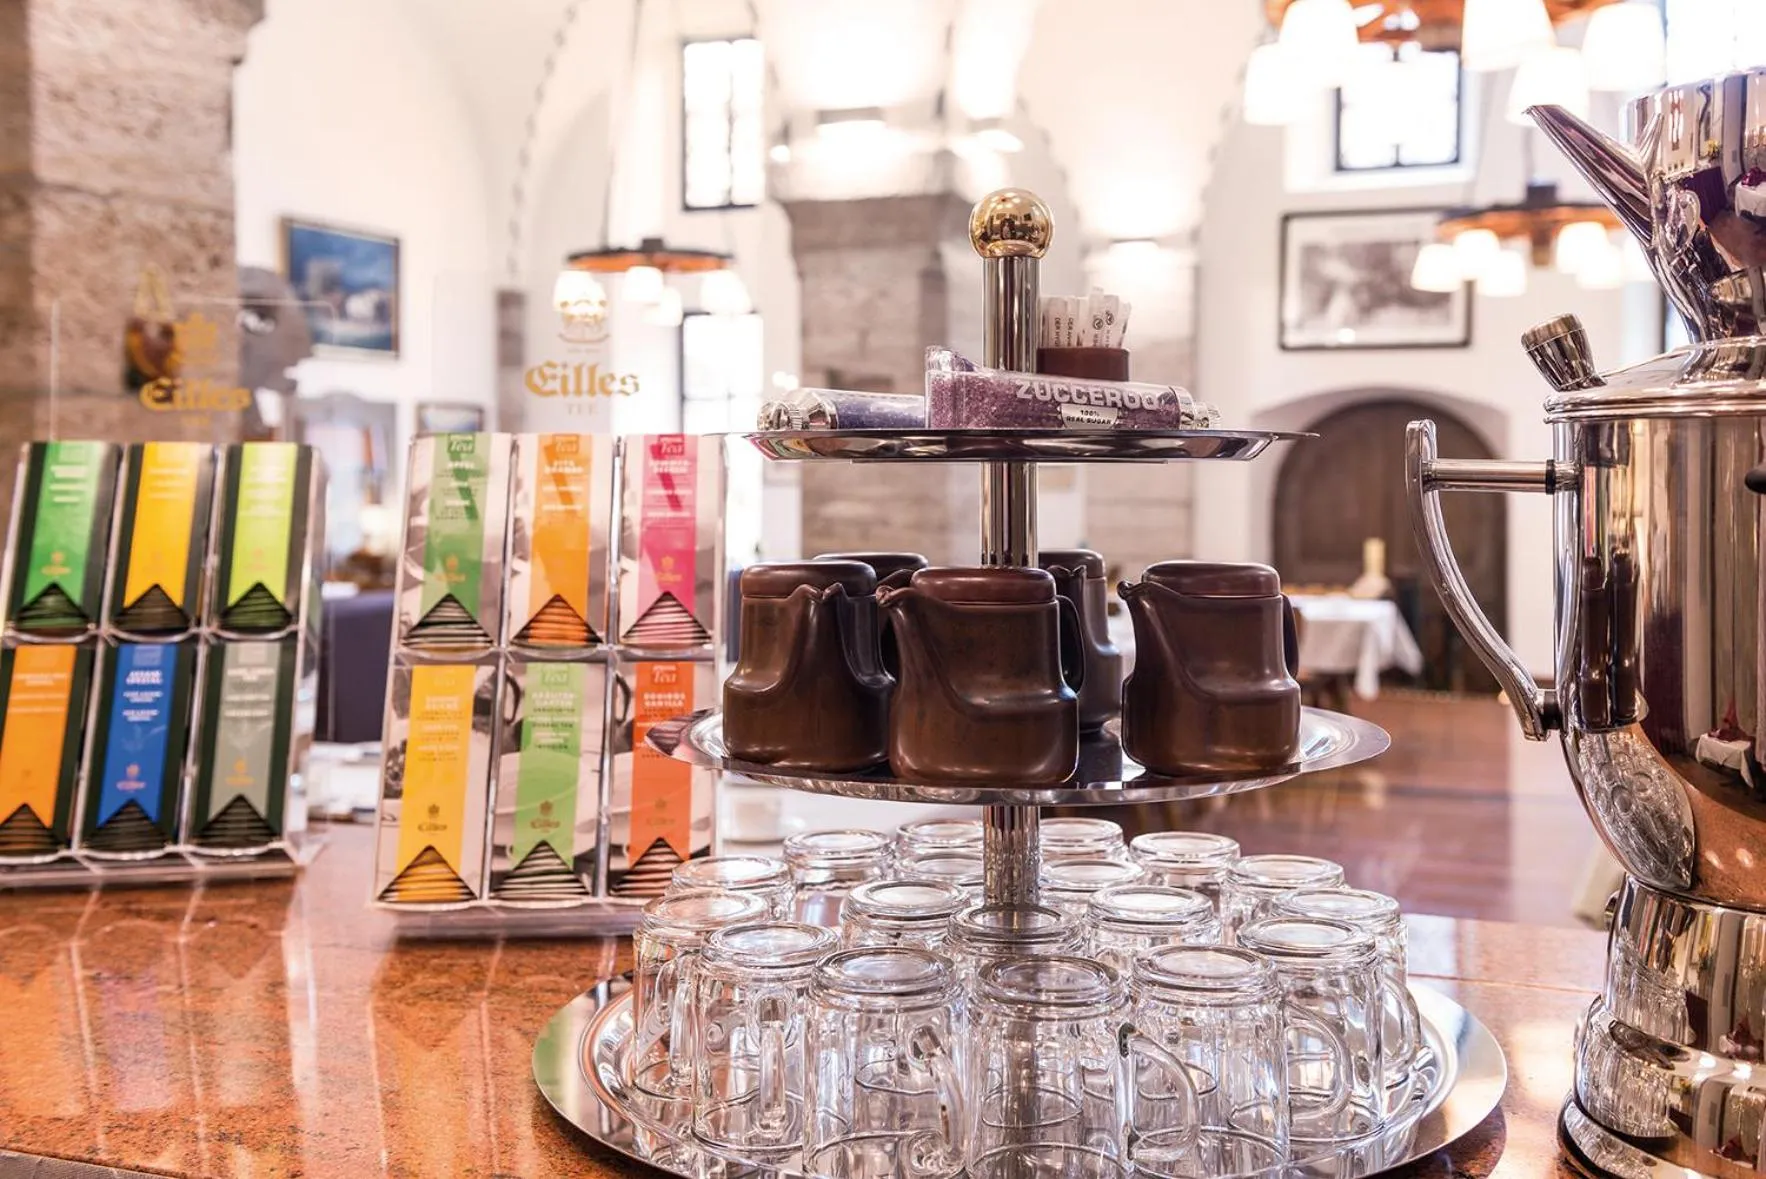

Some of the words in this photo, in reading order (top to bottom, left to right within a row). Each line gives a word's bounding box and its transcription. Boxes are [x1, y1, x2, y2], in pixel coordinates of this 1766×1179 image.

[525, 360, 639, 397] Eilles
[1066, 416, 1085, 424] REAL
[1086, 417, 1112, 425] SUGAR
